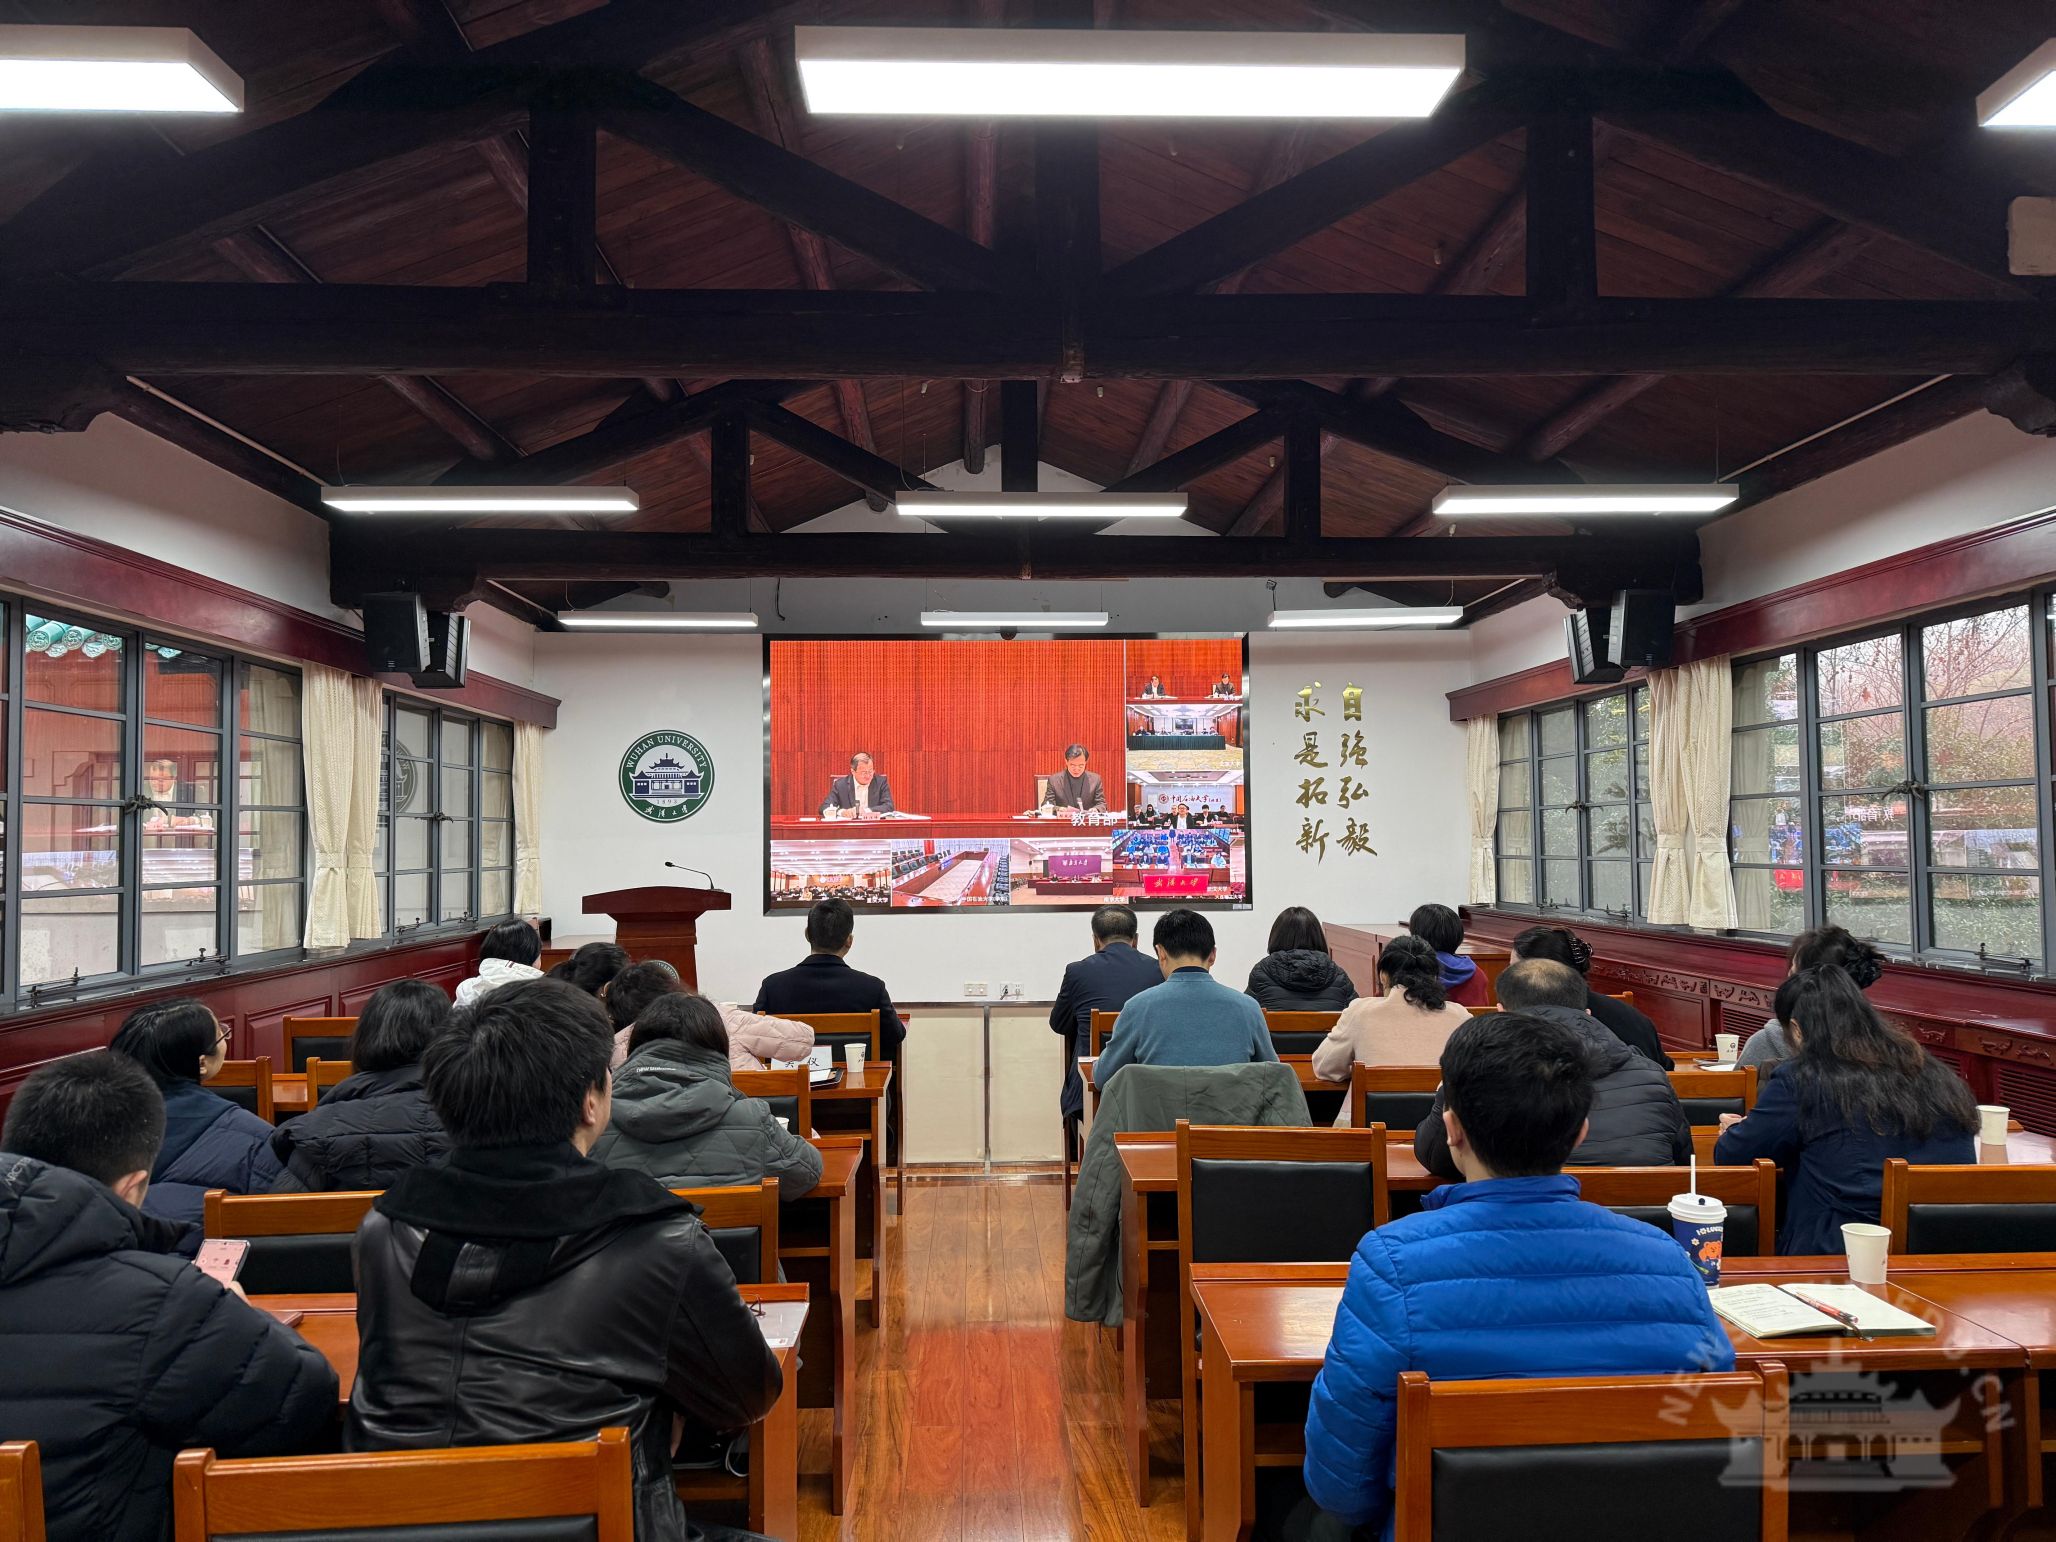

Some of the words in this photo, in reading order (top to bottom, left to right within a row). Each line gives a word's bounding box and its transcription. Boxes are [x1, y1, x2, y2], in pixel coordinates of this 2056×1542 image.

[626, 738, 655, 768] WUHAN
[657, 735, 707, 767] UNIVERSITY
[1071, 811, 1118, 826] 教育部
